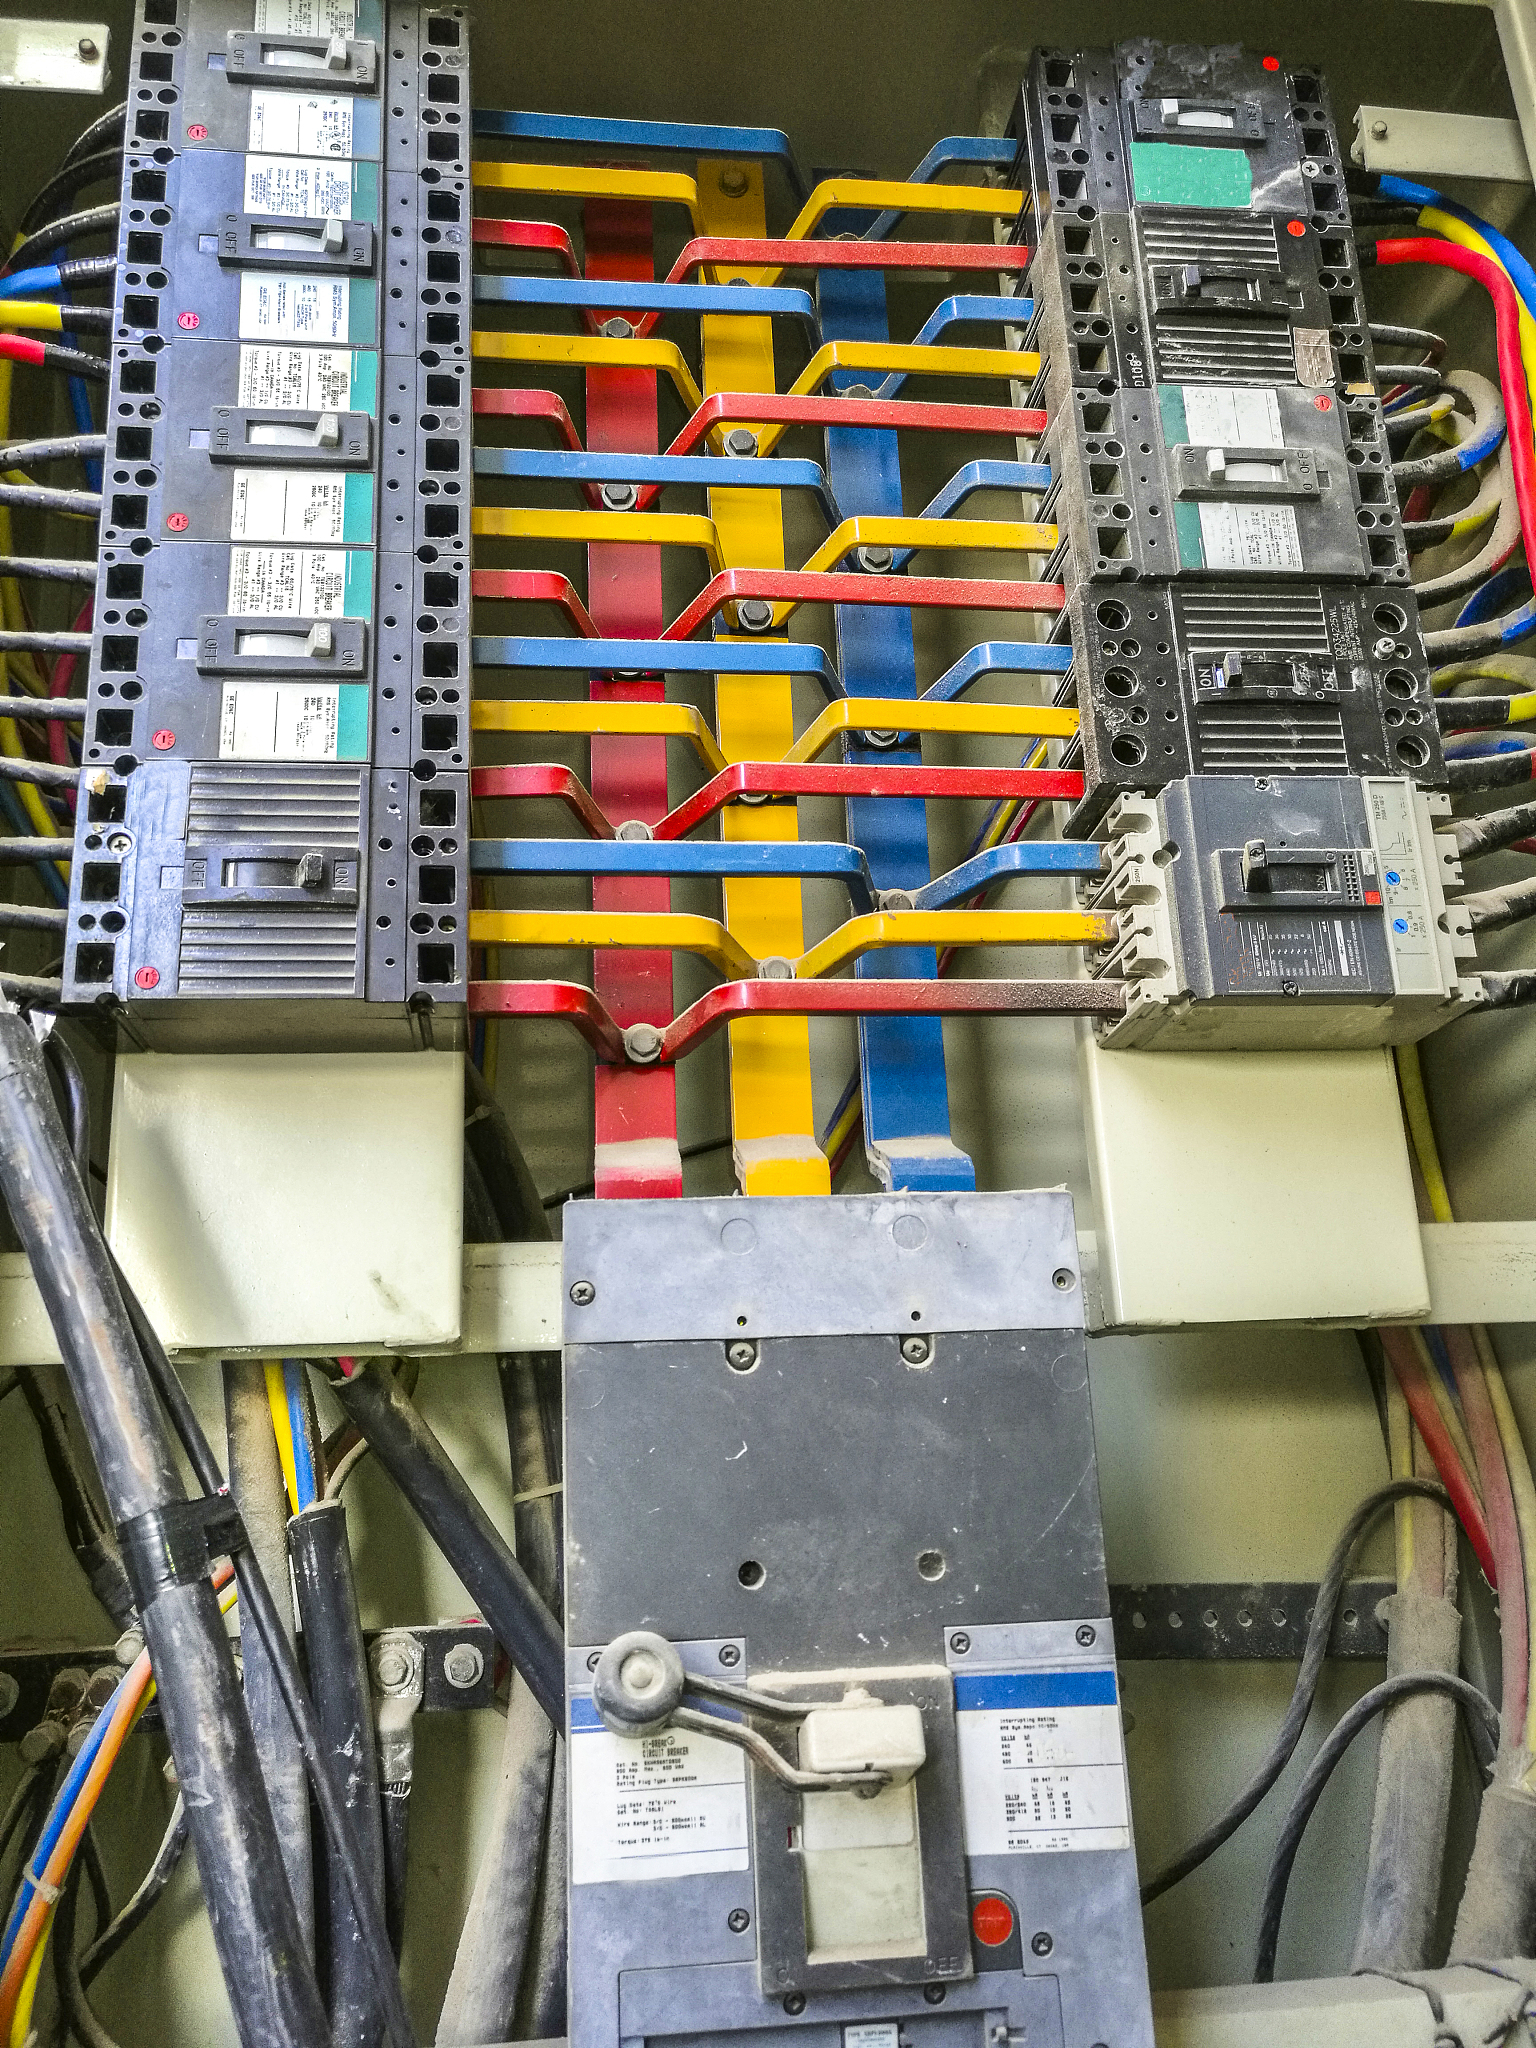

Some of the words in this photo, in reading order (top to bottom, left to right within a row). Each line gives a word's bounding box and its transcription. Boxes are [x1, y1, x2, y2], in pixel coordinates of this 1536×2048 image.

[233, 49, 245, 69] OFF
[356, 65, 369, 80] ON
[225, 231, 237, 254] OFF
[353, 246, 366, 263] ON
[1160, 282, 1172, 297] ON
[217, 428, 230, 451] OFF
[348, 440, 361, 456] ON
[1183, 448, 1196, 463] ON
[1298, 452, 1311, 474] OFF
[325, 573, 333, 590] CIRCUIT
[333, 573, 342, 598] INDUSTRIAL
[324, 592, 333, 611] BREAKER
[318, 626, 329, 643] 100
[1329, 606, 1344, 661] TQD34225WL
[205, 638, 218, 663] OFF
[342, 649, 355, 666] ON
[1198, 669, 1212, 688] ON
[1320, 666, 1336, 690] OFF
[192, 861, 206, 887] OFF
[335, 866, 350, 886] ON
[916, 1695, 941, 1711] ON
[642, 1747, 664, 1758] CIRCUIT
[667, 1746, 690, 1757] BREAKER
